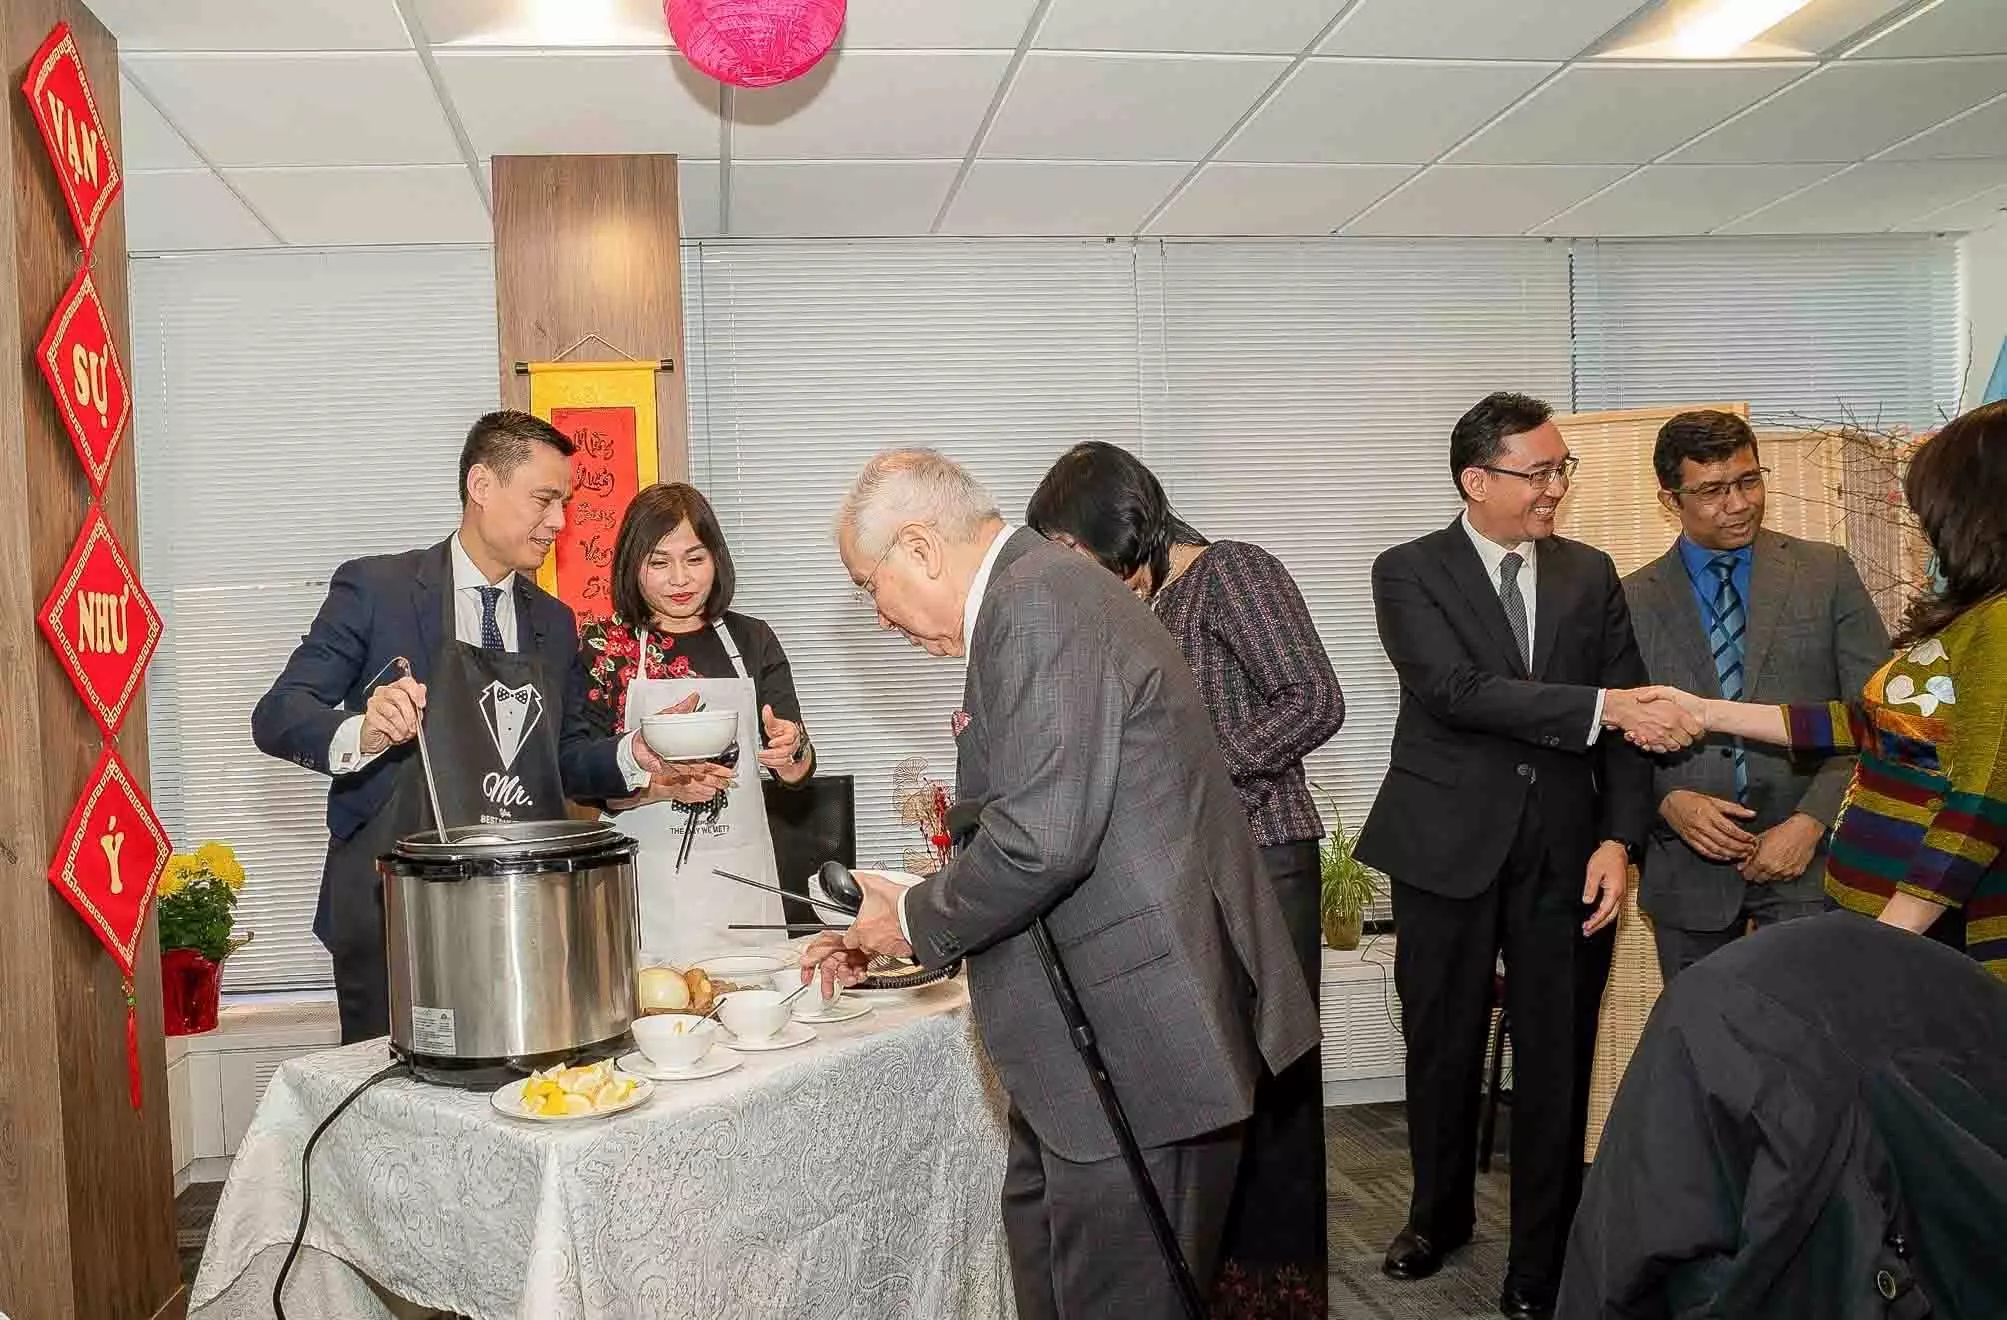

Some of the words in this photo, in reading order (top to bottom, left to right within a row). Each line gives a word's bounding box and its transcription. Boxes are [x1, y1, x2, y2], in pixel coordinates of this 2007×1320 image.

[47, 89, 98, 189] VẠN
[72, 343, 109, 428] SỰ
[78, 584, 130, 655] NHƯ
[483, 772, 533, 806] Mr.
[101, 816, 124, 895] Ý
